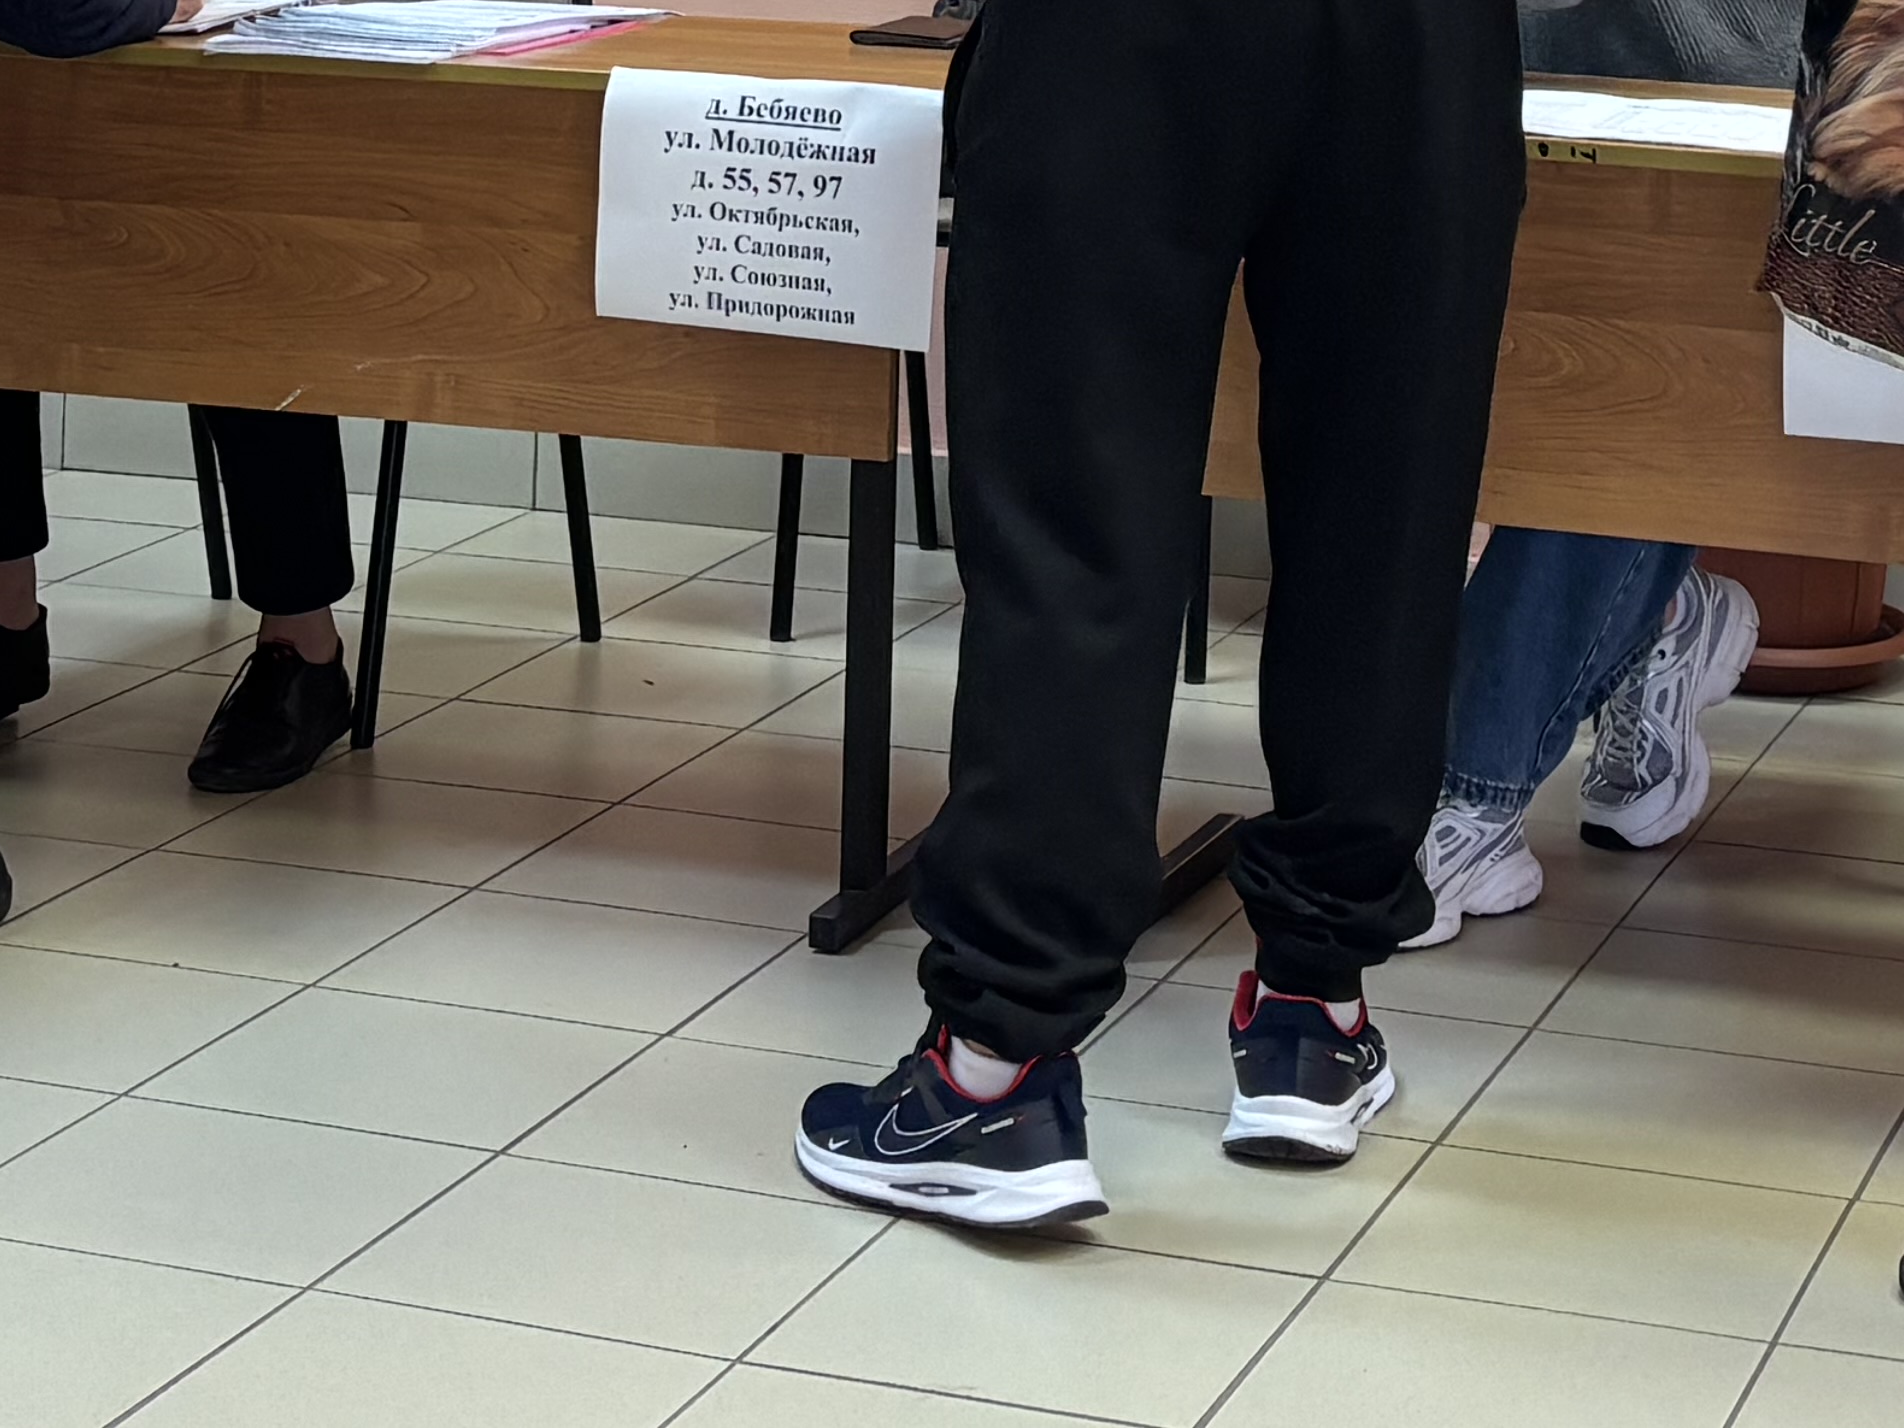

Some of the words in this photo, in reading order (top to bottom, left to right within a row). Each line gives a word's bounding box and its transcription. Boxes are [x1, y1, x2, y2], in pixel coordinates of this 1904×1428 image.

[705, 97, 728, 120] д.
[738, 95, 843, 126] Бебяево
[664, 130, 701, 153] ул.
[710, 128, 876, 165] Молодёжная
[691, 171, 714, 190] д.
[722, 167, 759, 197] 55,
[768, 171, 804, 200] 57,
[813, 175, 843, 199] 97
[671, 203, 702, 223] ул.
[709, 201, 860, 236] Октябрьская,
[1780, 183, 1877, 265] Little
[696, 235, 727, 255] ул.
[734, 234, 831, 265] Садовая,
[693, 264, 724, 284] ул.
[730, 265, 832, 295] Союзная,
[668, 291, 699, 311] ул.
[706, 292, 855, 325] Придорожная
